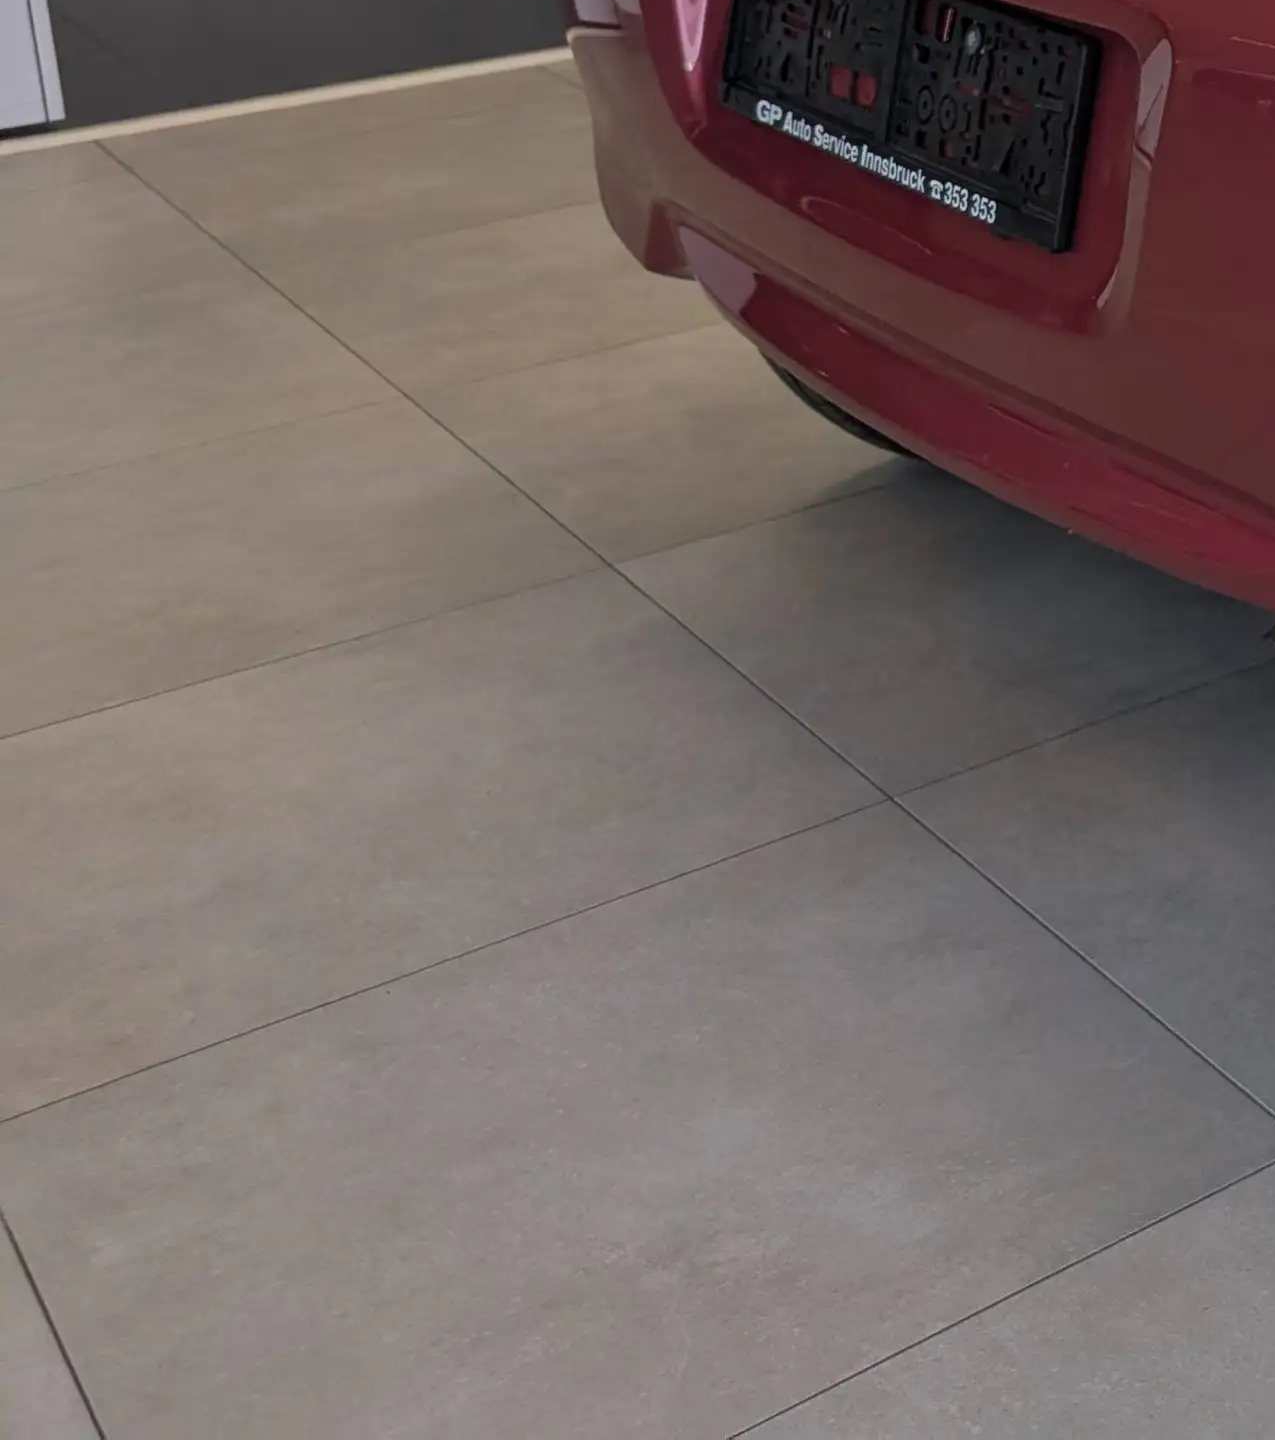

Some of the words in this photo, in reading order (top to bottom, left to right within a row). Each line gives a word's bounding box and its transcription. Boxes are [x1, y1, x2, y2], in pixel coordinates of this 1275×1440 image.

[756, 99, 783, 126] GP
[782, 110, 812, 141] Auto
[814, 124, 859, 163] Service
[860, 144, 926, 193] Innsbruck
[943, 181, 969, 212] 353
[970, 193, 997, 224] 353
